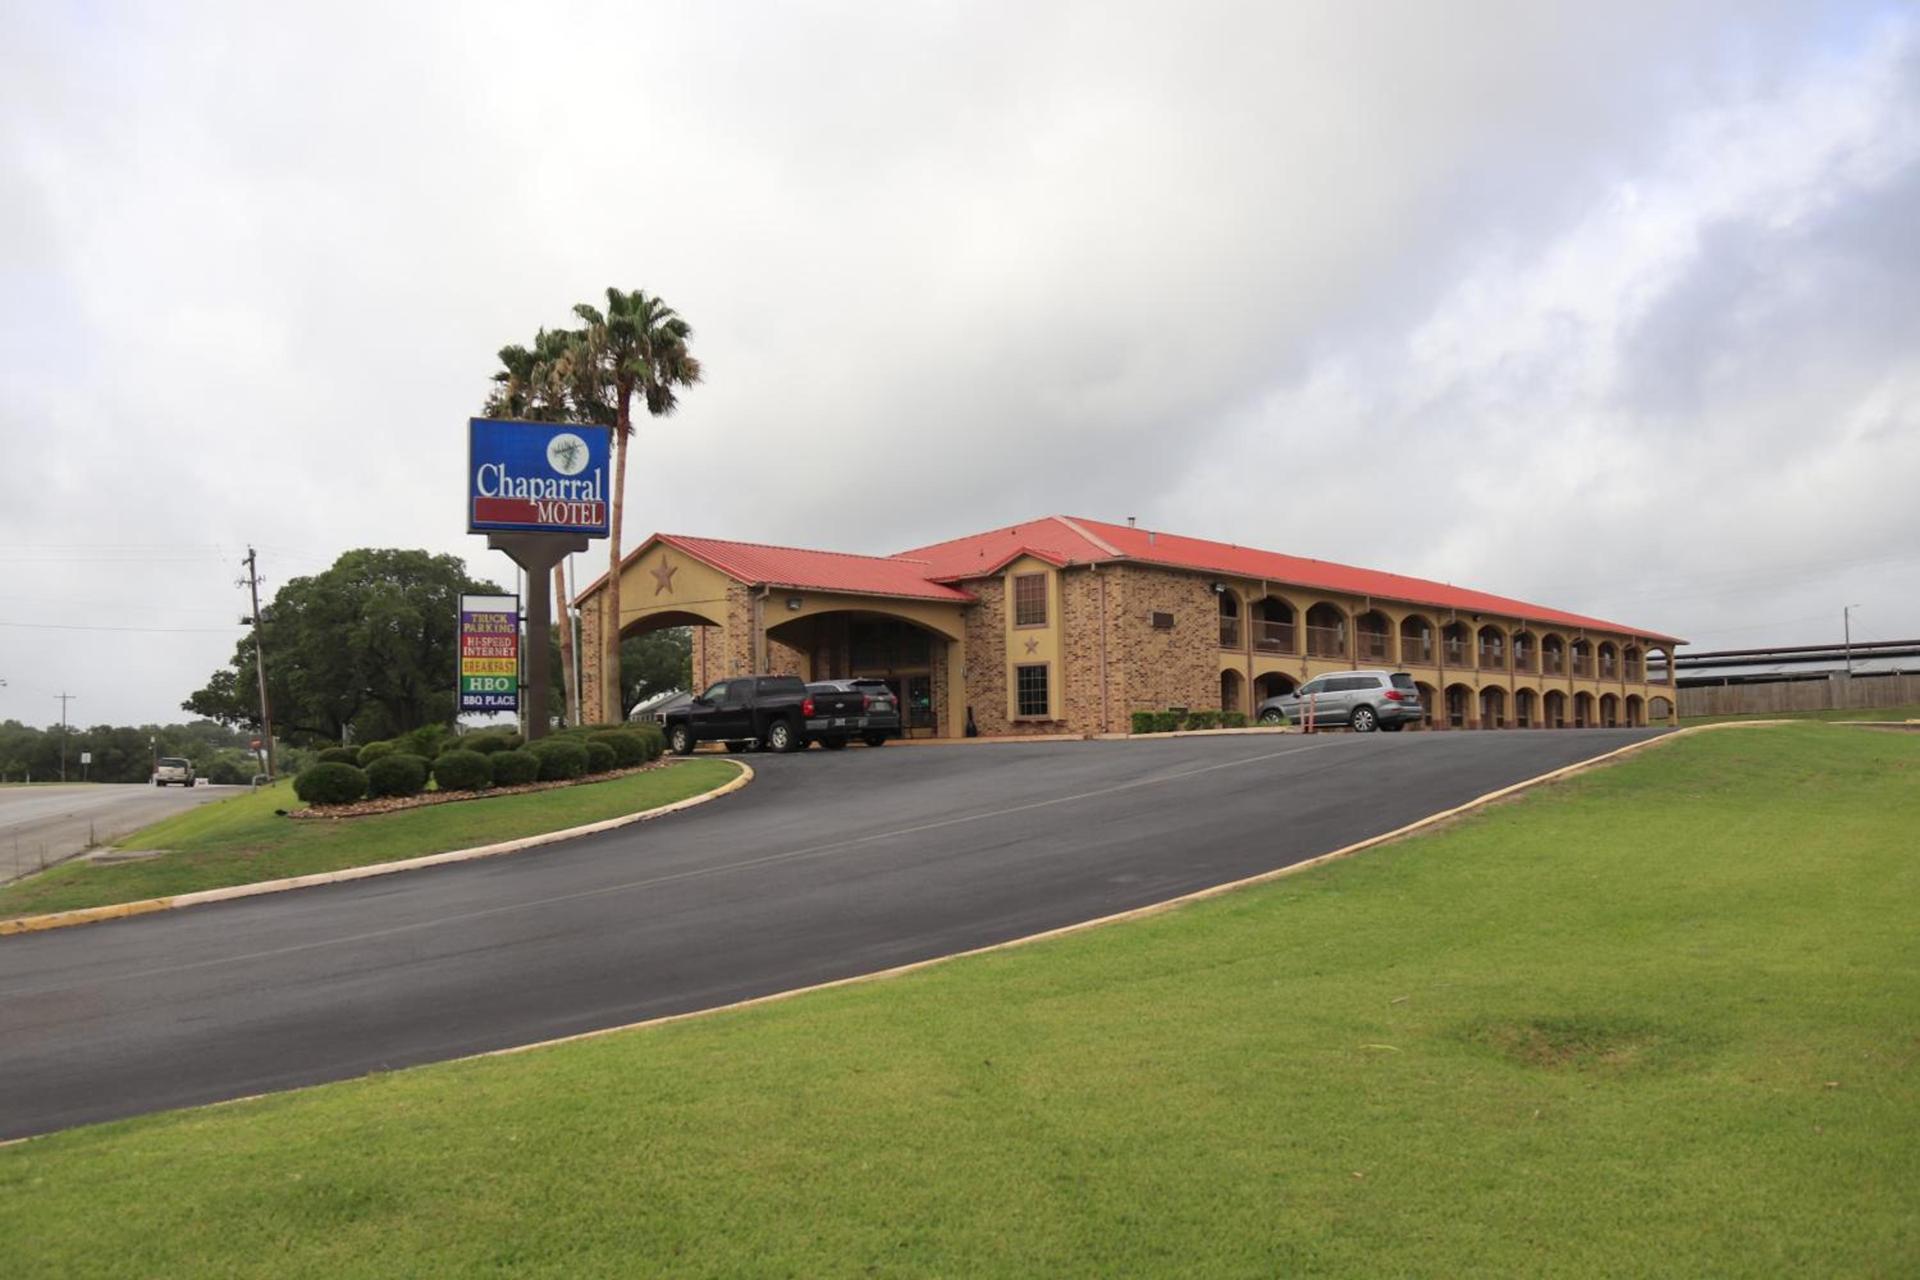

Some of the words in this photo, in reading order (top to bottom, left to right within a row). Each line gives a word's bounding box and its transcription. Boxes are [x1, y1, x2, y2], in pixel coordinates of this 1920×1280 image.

[477, 462, 602, 505] Chaparral
[537, 501, 601, 525] MOTEL
[471, 614, 508, 623] TRUCK
[463, 623, 515, 633] PARKING
[467, 637, 512, 647] HI-SPEED
[463, 647, 516, 657] INTERNET
[464, 661, 514, 673] BREAKFAST
[470, 678, 509, 691] HBO
[463, 695, 482, 705] BBQ
[485, 696, 516, 706] PLACE
